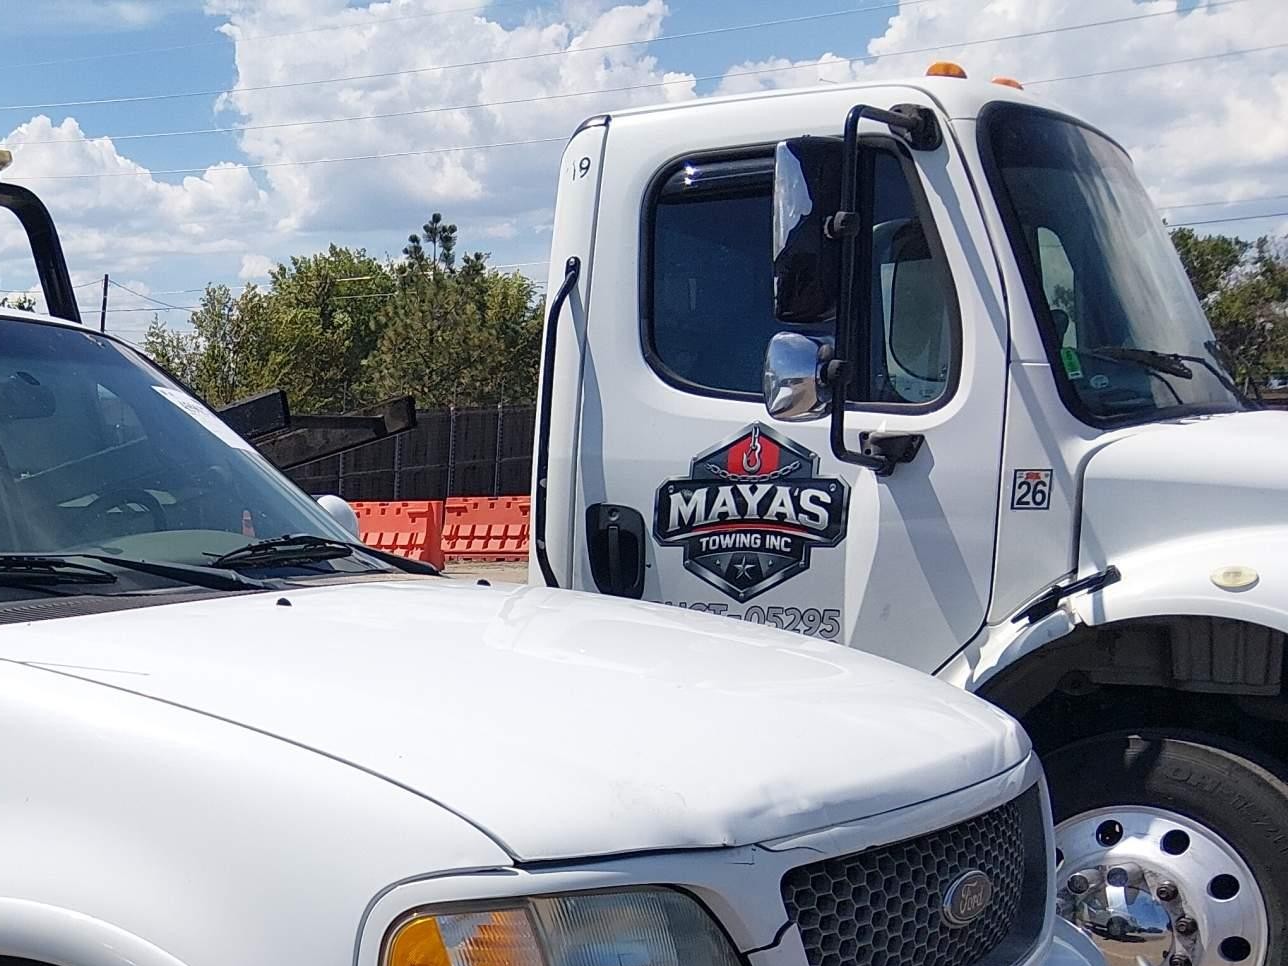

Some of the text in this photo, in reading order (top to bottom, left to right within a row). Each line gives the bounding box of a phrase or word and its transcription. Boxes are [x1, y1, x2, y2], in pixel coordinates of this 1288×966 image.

[1016, 480, 1048, 506] 26
[667, 484, 832, 533] MAYA'S
[700, 534, 793, 552] TOWING INC
[959, 880, 984, 915] Ford
